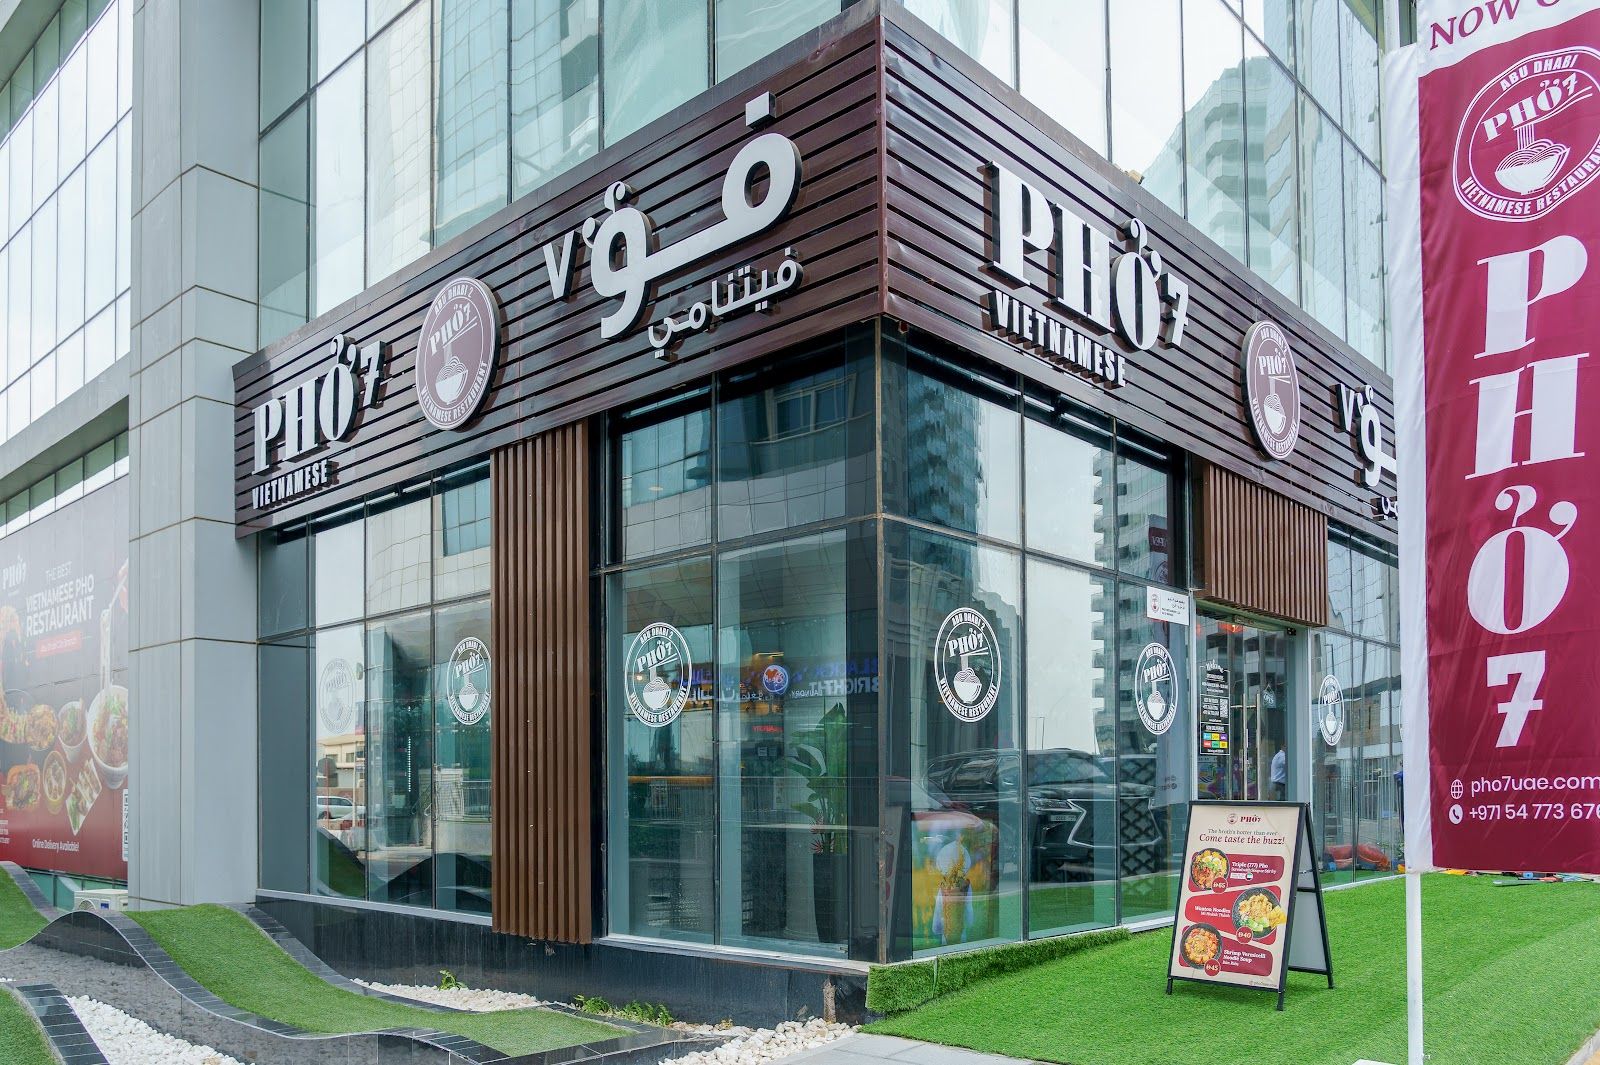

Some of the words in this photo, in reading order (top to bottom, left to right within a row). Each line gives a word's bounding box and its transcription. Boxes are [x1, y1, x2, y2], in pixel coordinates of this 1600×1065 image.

[1430, 0, 1520, 51] NOW
[1500, 66, 1528, 91] ABU
[1533, 54, 1578, 74] DHABI
[1460, 176, 1531, 215] VIETNAMESE
[1536, 140, 1600, 212] RESTAURA
[434, 294, 447, 316] ABU
[447, 284, 468, 300] DHABI
[468, 286, 474, 298] 2
[648, 247, 797, 359] فيتنامي
[995, 290, 1126, 388] VIETNAMESE
[420, 385, 452, 422] VIETNAMESE
[452, 360, 488, 422] RESTAURANT
[251, 460, 329, 510] VIETNAMESE
[26, 581, 74, 613] VIETNAMESE
[75, 574, 95, 596] PHO
[26, 595, 94, 638] RESTAURANT
[1471, 775, 1600, 798] pho7uae.com
[1469, 804, 1501, 820] +971
[1505, 803, 1528, 820] 54
[1532, 803, 1565, 820] 773
[1200, 833, 1222, 842] Come
[1224, 835, 1245, 843] taste
[1247, 835, 1261, 844] the
[1263, 836, 1285, 845] buzz!
